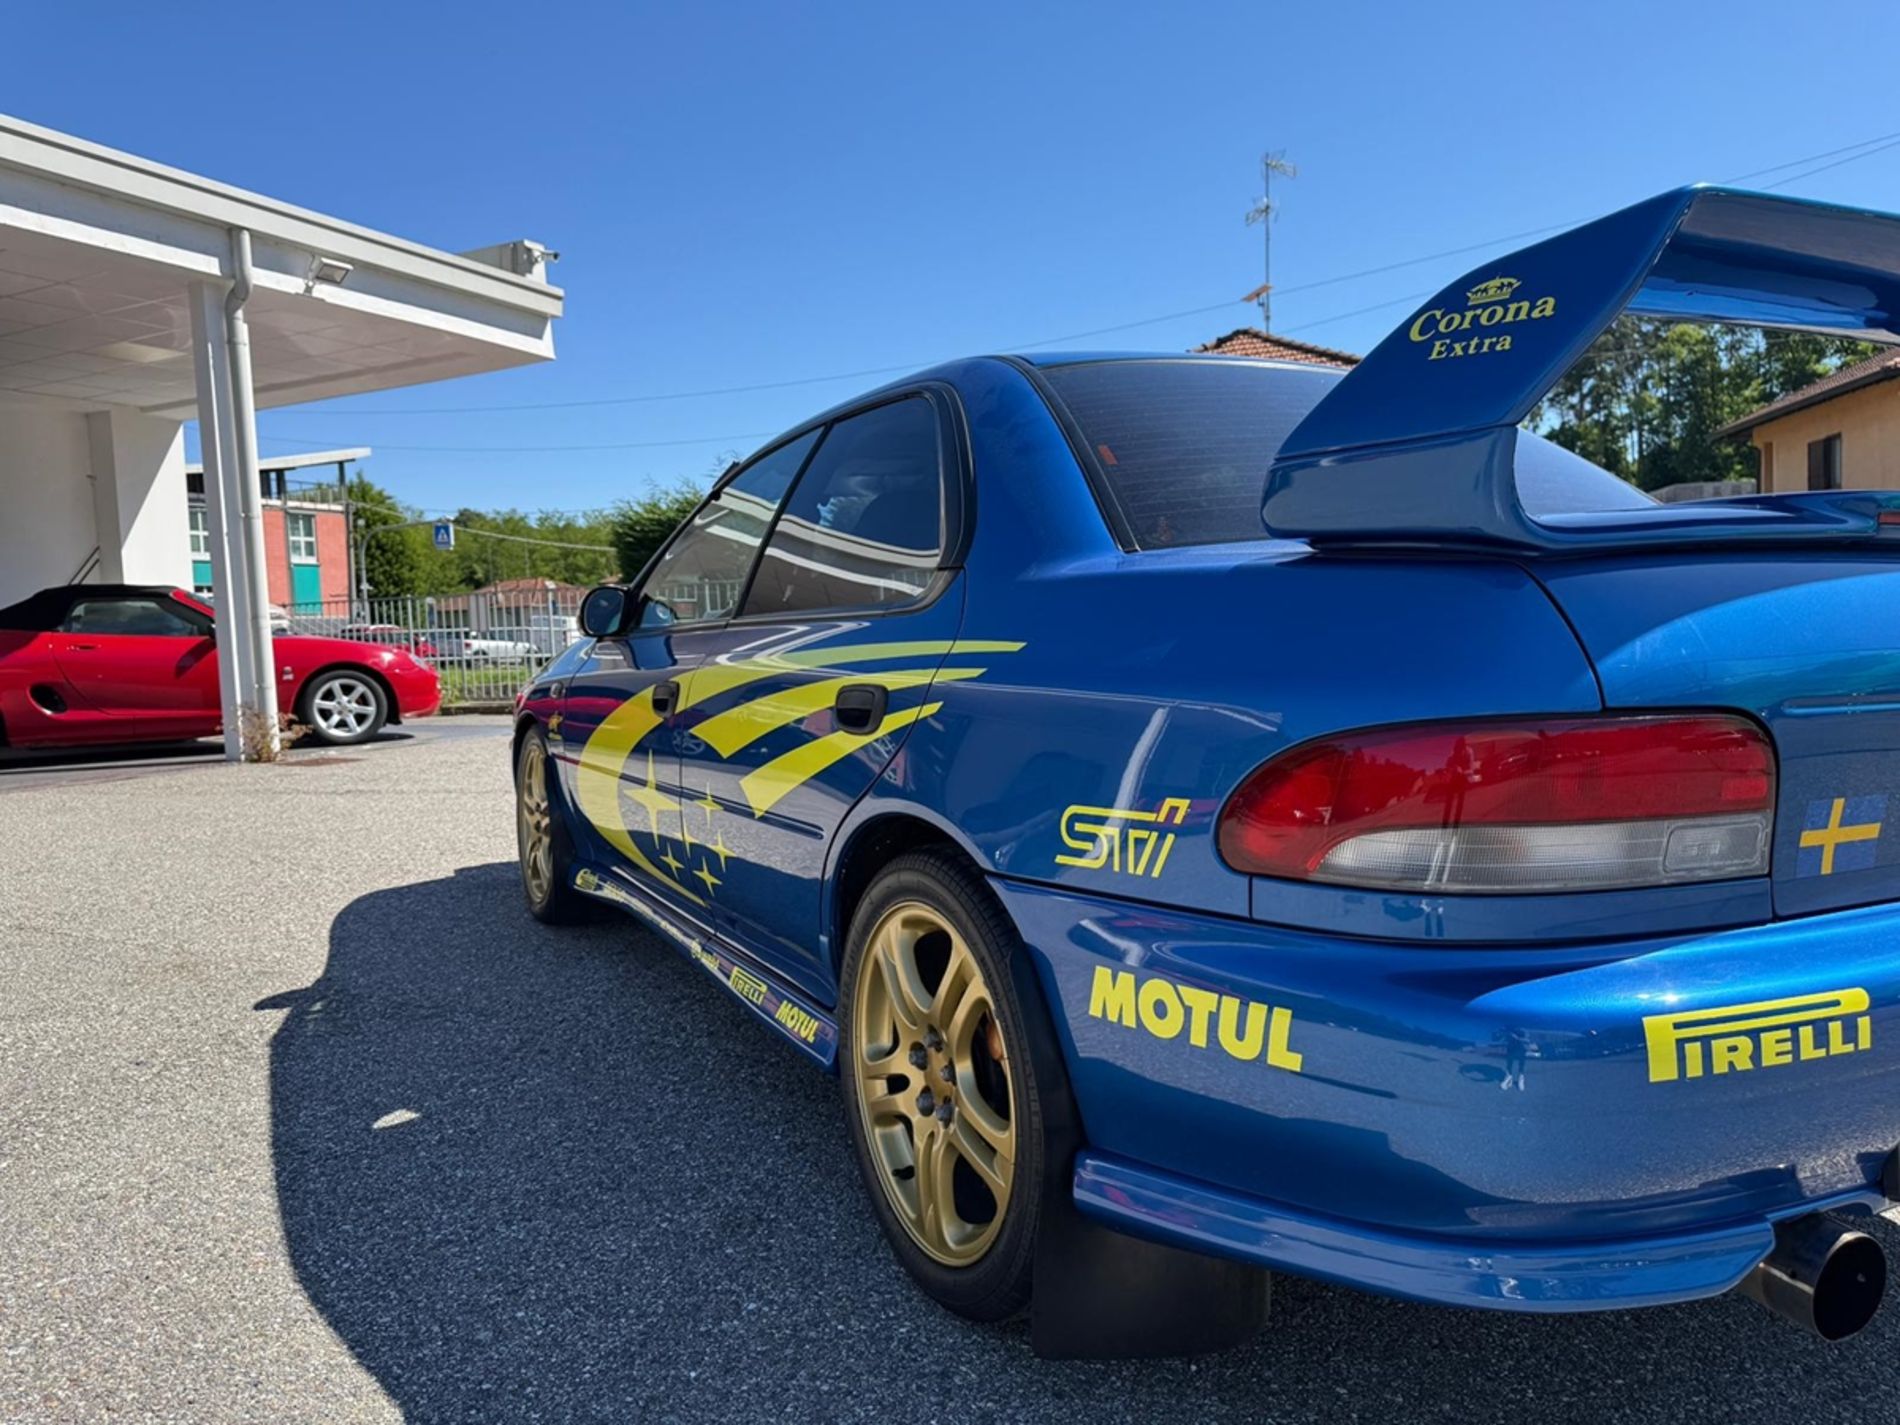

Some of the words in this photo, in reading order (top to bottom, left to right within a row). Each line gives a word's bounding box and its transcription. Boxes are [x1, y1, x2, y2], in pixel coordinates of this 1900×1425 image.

[1409, 296, 1556, 342] Corona
[1428, 335, 1512, 360] Extra
[729, 967, 767, 1005] PIRELLI
[775, 1000, 820, 1043] MOTUL
[1089, 966, 1303, 1072] MOTUL
[1642, 987, 1871, 1083] PIRELLI
